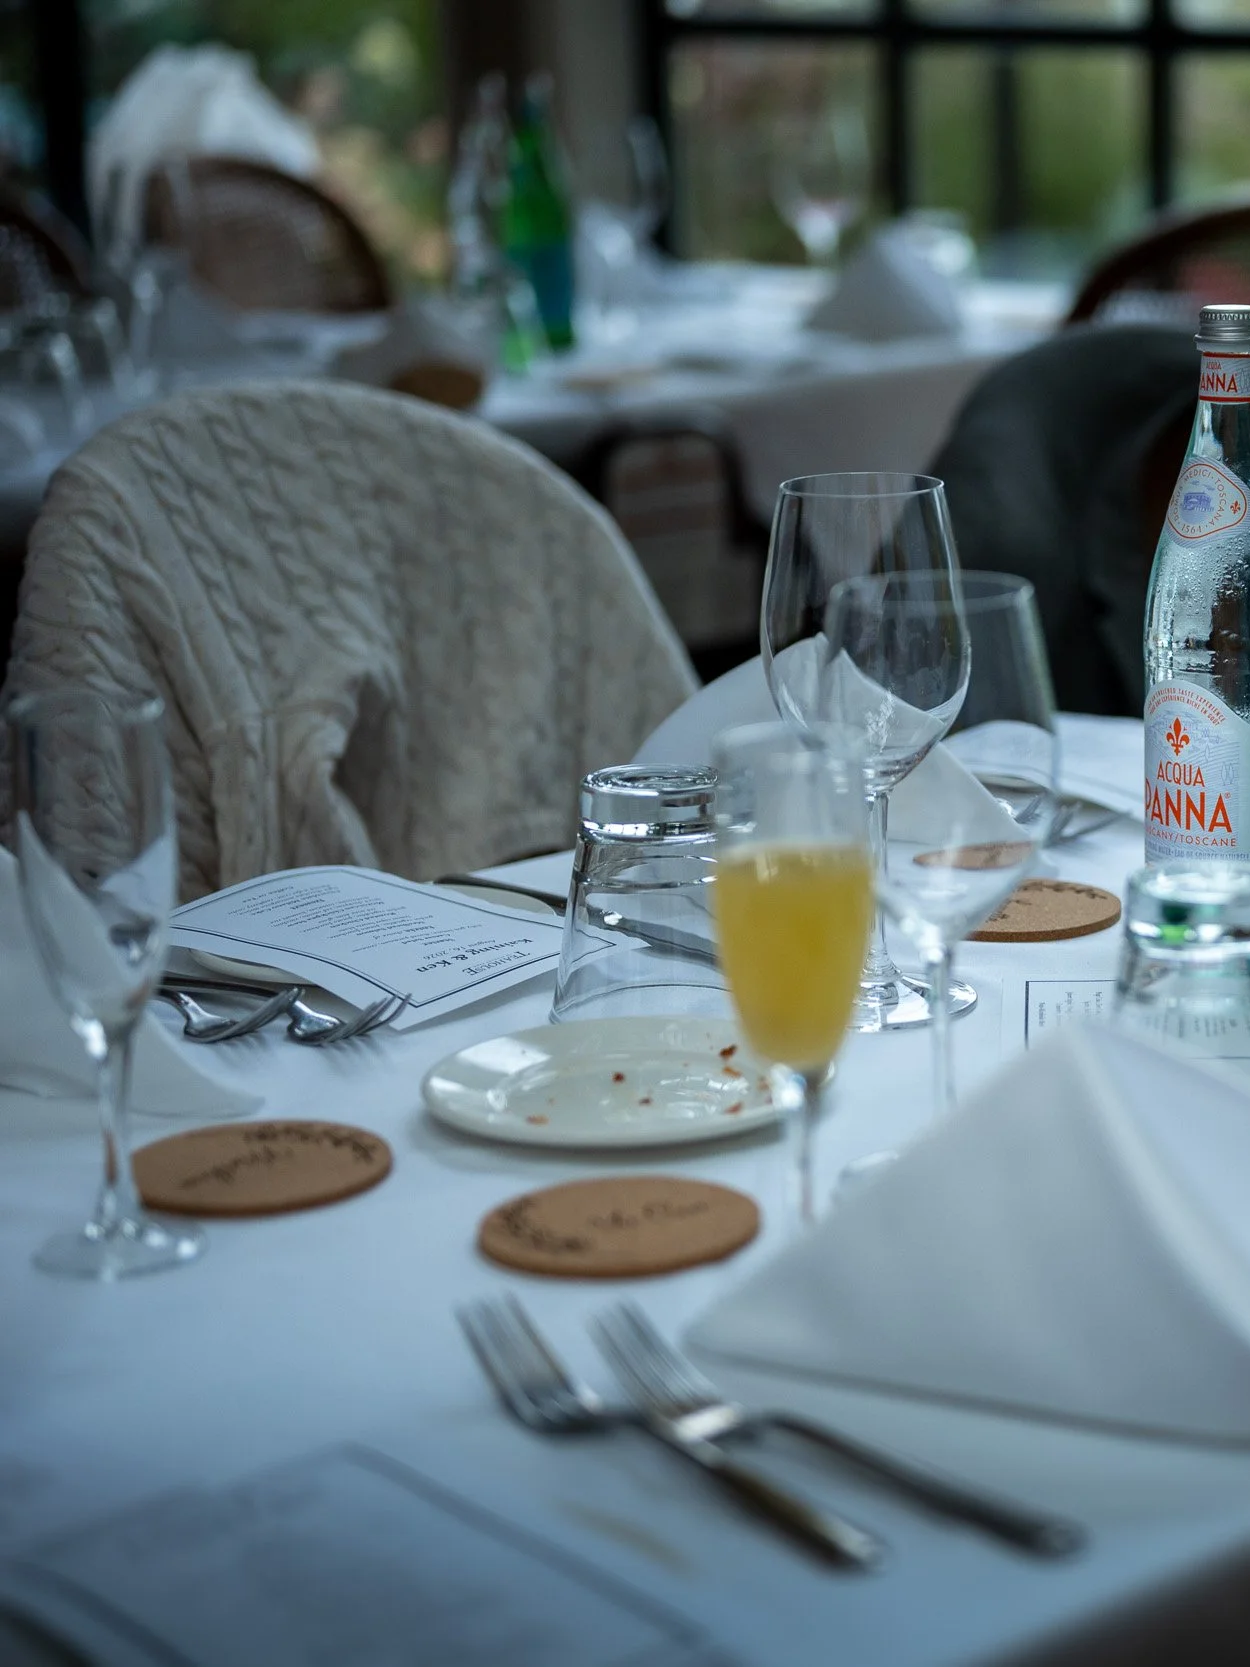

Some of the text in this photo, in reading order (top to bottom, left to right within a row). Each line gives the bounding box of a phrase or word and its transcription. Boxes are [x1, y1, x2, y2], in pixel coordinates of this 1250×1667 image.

[1208, 478, 1227, 526] TOSCANA
[1157, 760, 1205, 787] ACQUA
[416, 960, 451, 973] Ken
[461, 951, 530, 976] TEAHOUSE
